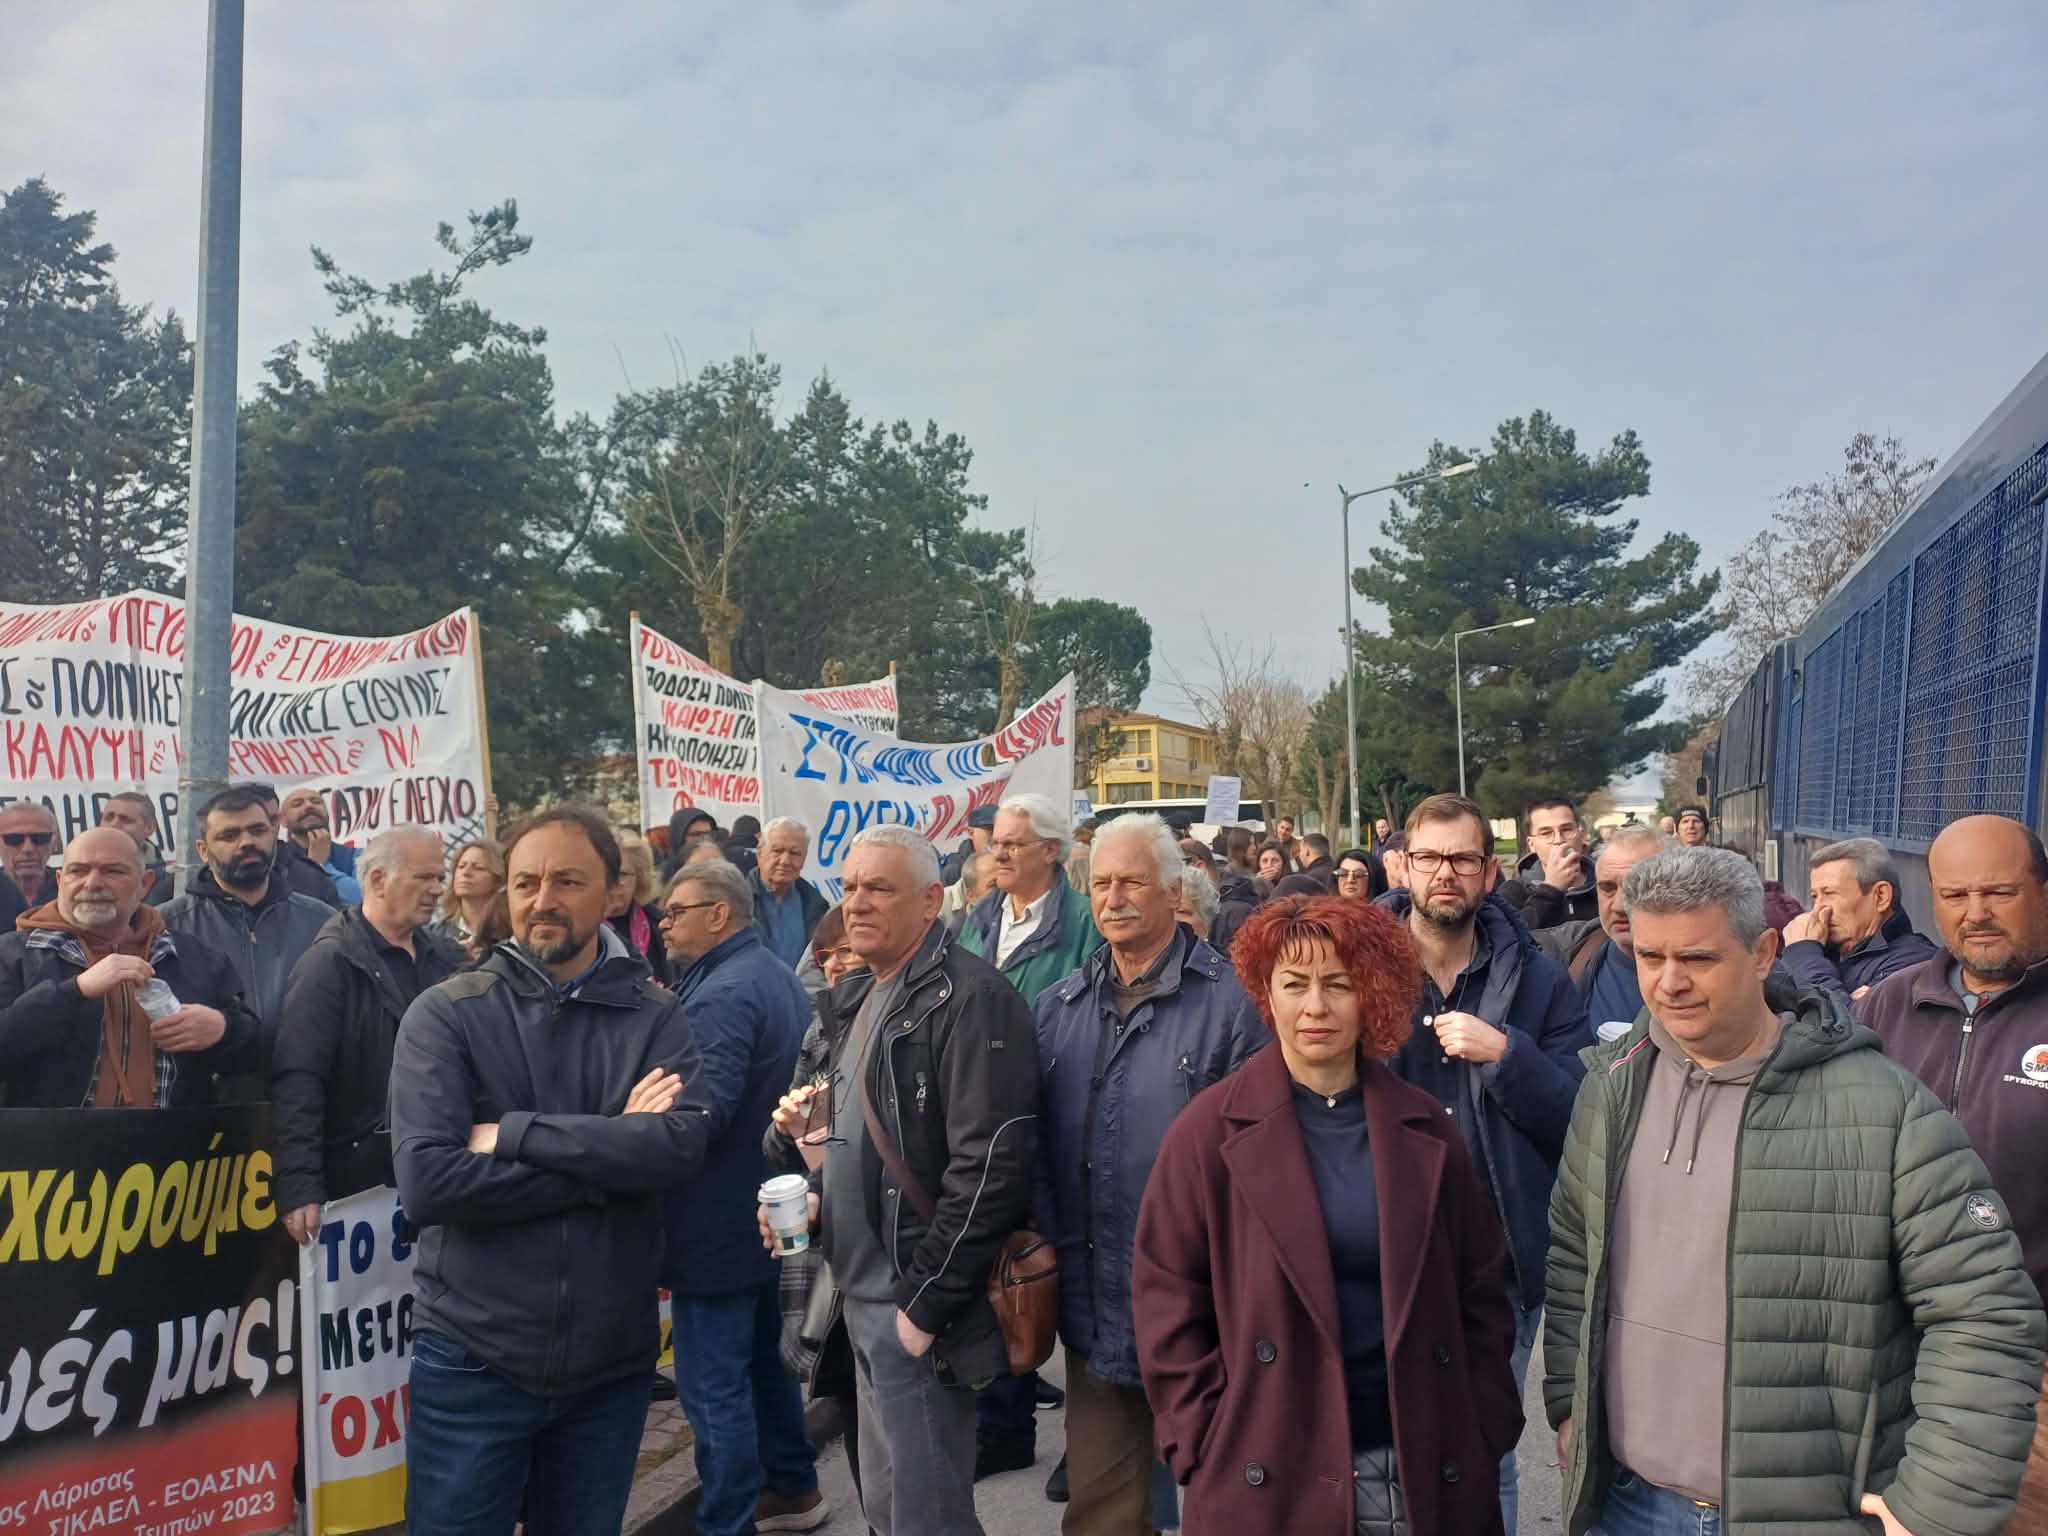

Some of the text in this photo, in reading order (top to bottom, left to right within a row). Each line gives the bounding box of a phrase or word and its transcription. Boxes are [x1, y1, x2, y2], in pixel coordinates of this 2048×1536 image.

[0, 719, 145, 781] ΚΑΛΥΨΗ
[0, 1131, 277, 1276] χωρούμε
[138, 1278, 295, 1428] μας!
[33, 1468, 136, 1516] Λάρισας
[48, 1494, 141, 1536] ΣΙΚΑΕΛ
[163, 1459, 278, 1507] ΕΟΑΣΝΛ
[220, 1491, 276, 1524] 2023
